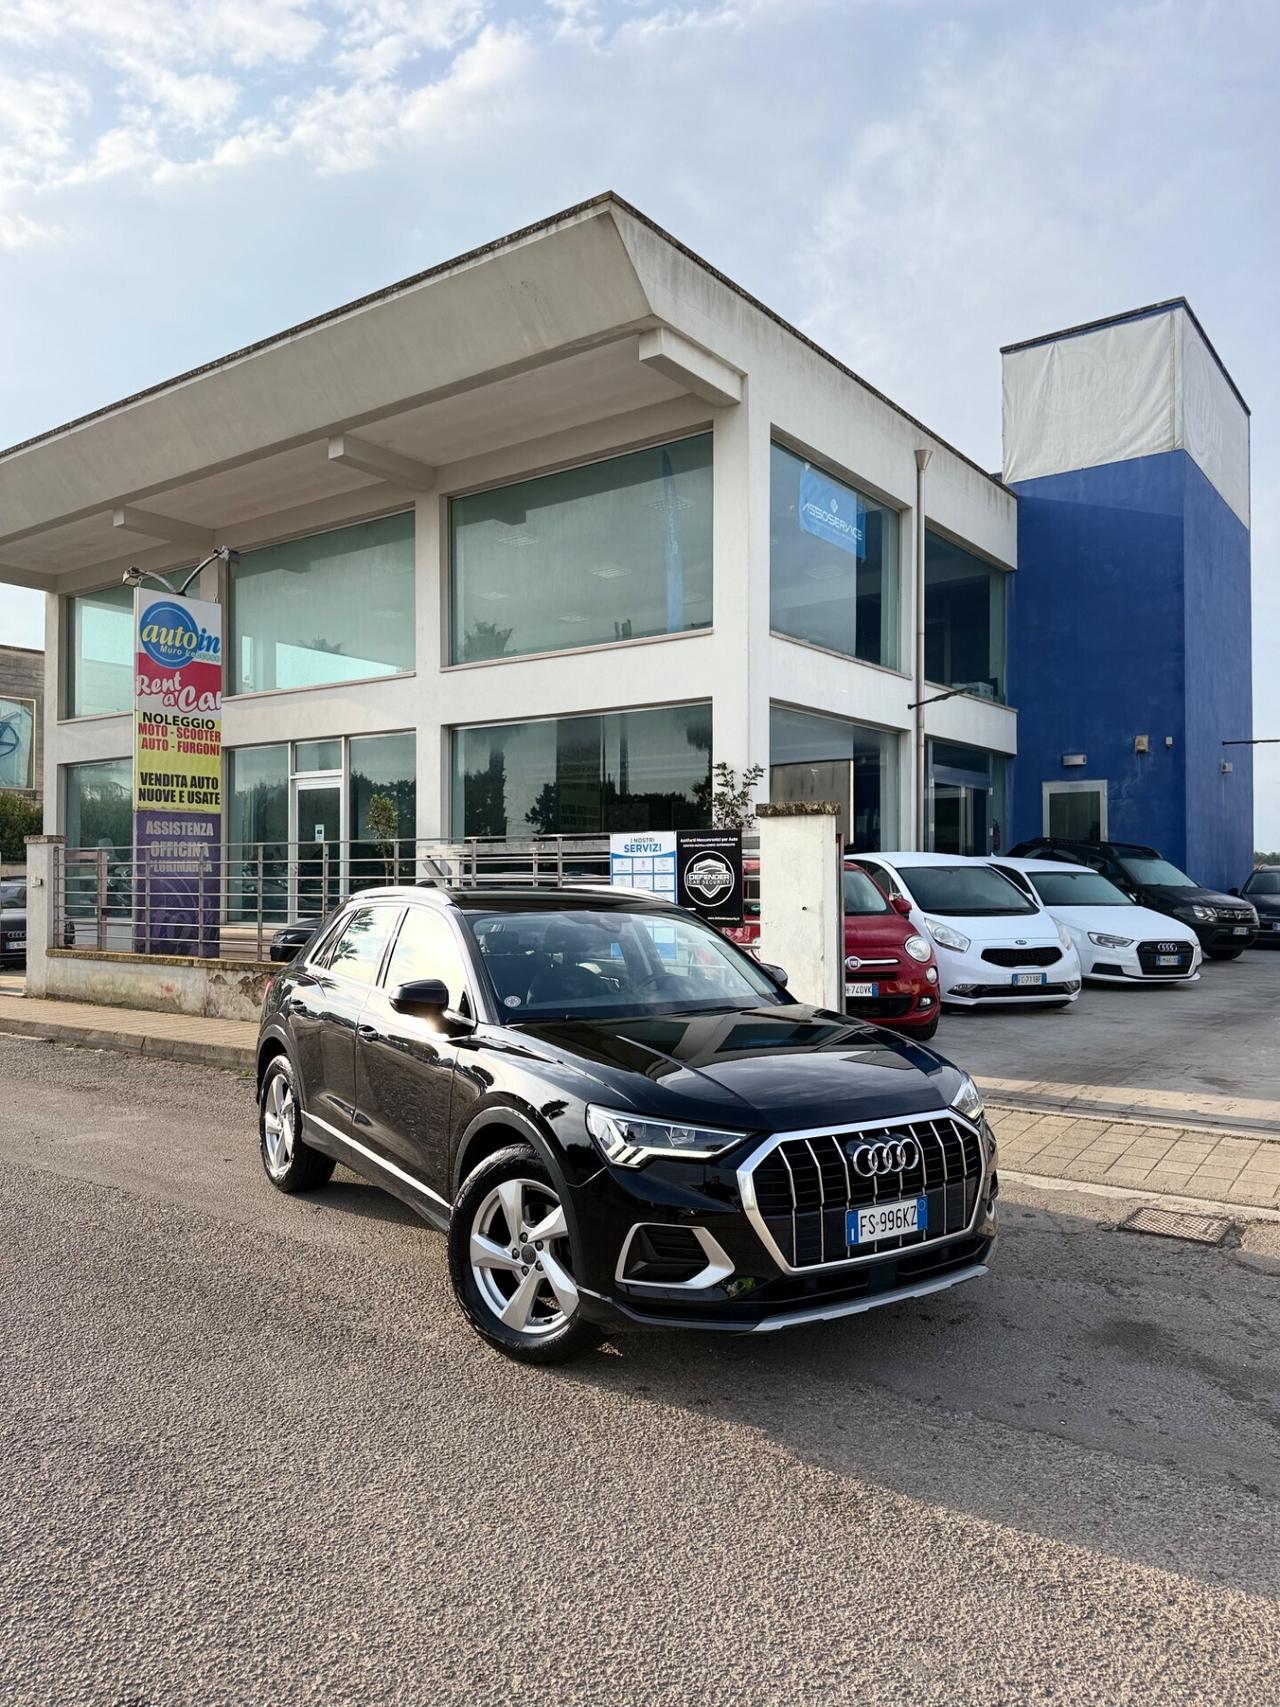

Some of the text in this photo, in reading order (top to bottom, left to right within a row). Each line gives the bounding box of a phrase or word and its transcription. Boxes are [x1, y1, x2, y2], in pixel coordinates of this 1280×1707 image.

[160, 645, 182, 656] Muro
[137, 672, 181, 694] Rent
[142, 711, 215, 730] NOLEGGIO
[138, 722, 168, 737] MOTO
[176, 728, 221, 743] SCOOTER
[141, 737, 169, 751] AUTO
[177, 741, 220, 756] FURGONI
[140, 772, 219, 790] VENDITA AUTO
[138, 787, 221, 805] NUOVE E USATE
[146, 821, 214, 836] ASSISTENZA
[150, 841, 209, 857] OFFICINA
[624, 844, 662, 854] SERVIZI
